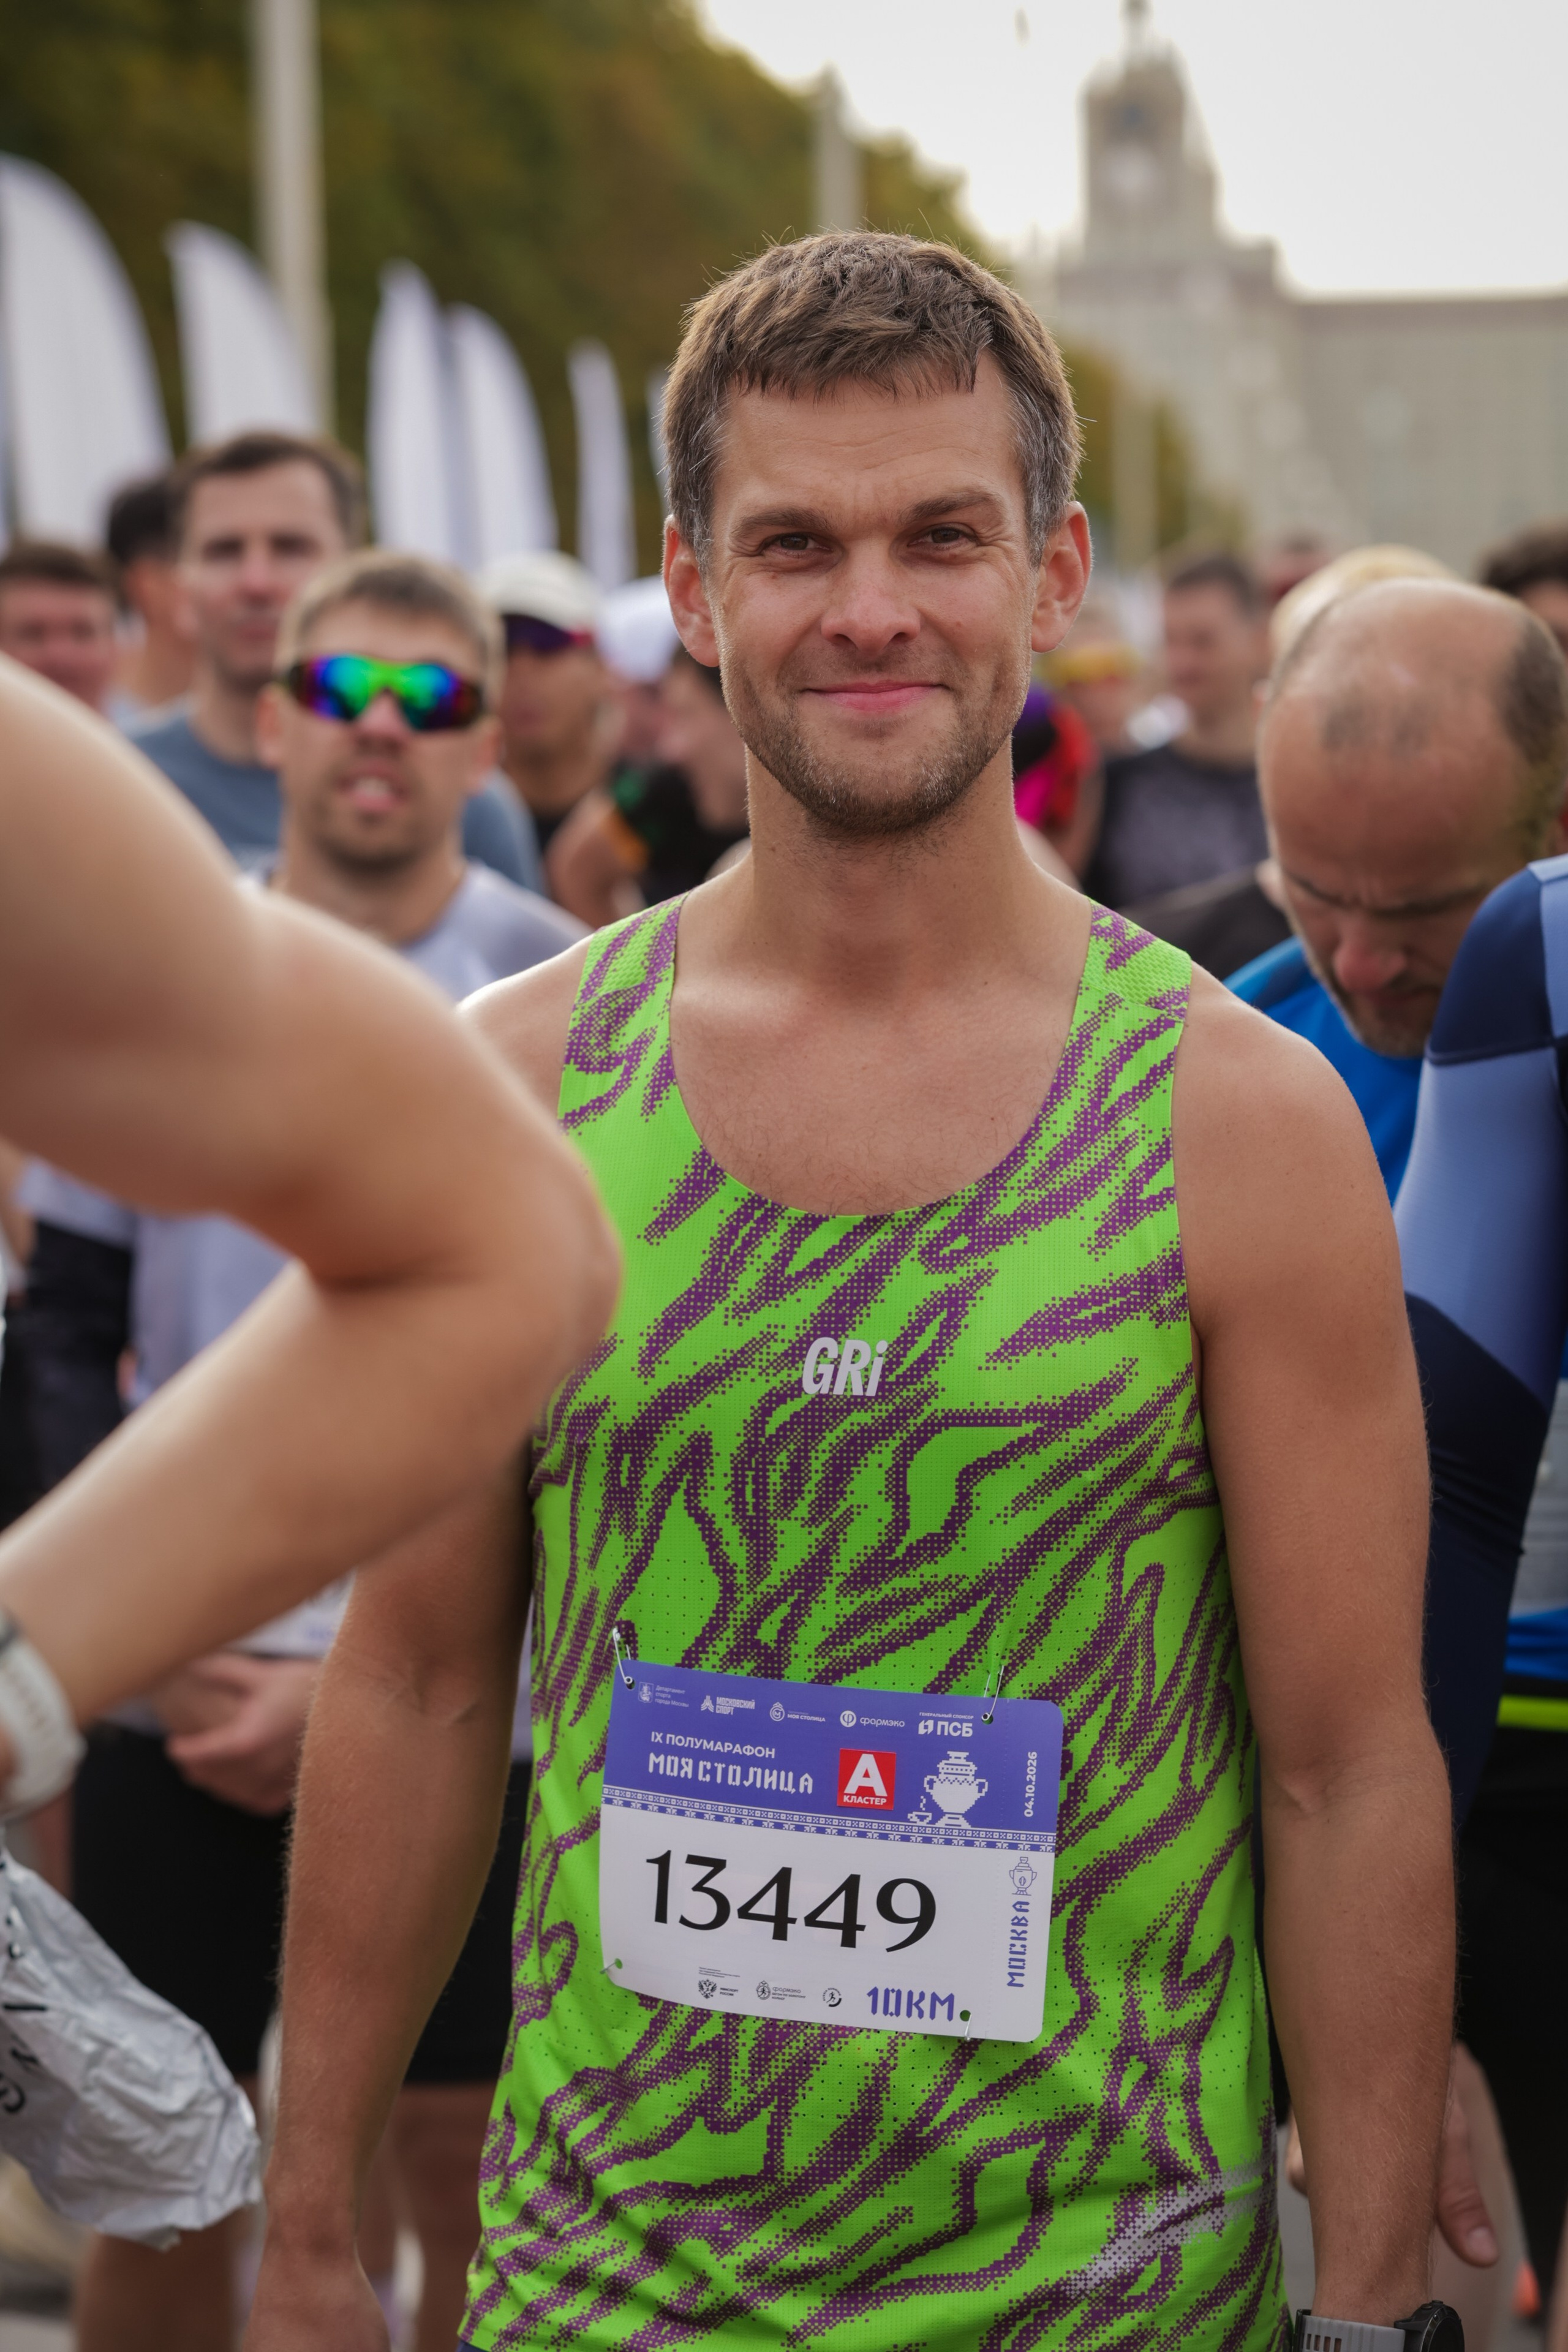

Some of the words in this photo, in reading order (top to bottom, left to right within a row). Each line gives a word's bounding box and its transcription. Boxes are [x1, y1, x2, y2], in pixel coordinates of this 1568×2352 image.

[802, 1337, 888, 1396] GRi
[655, 1685, 685, 1694] Департамент
[715, 1705, 734, 1715] СПОРТ
[716, 1697, 756, 1709] МОСКОВСКИЙ
[860, 1717, 905, 1727] фармэко
[937, 1721, 973, 1737] ПСБ
[650, 1732, 663, 1743] IX
[666, 1733, 775, 1758] ПОЛУМАРАФОН
[649, 1752, 693, 1779] МОЯ
[698, 1760, 813, 1795] СТОЛИЦА
[844, 1754, 888, 1796] А
[1024, 1751, 1038, 1817] 04.10.2026
[843, 1795, 887, 1805] КЛАСТЕР
[646, 1850, 936, 1953] 13449
[1006, 1901, 1030, 1988] МОСКВА
